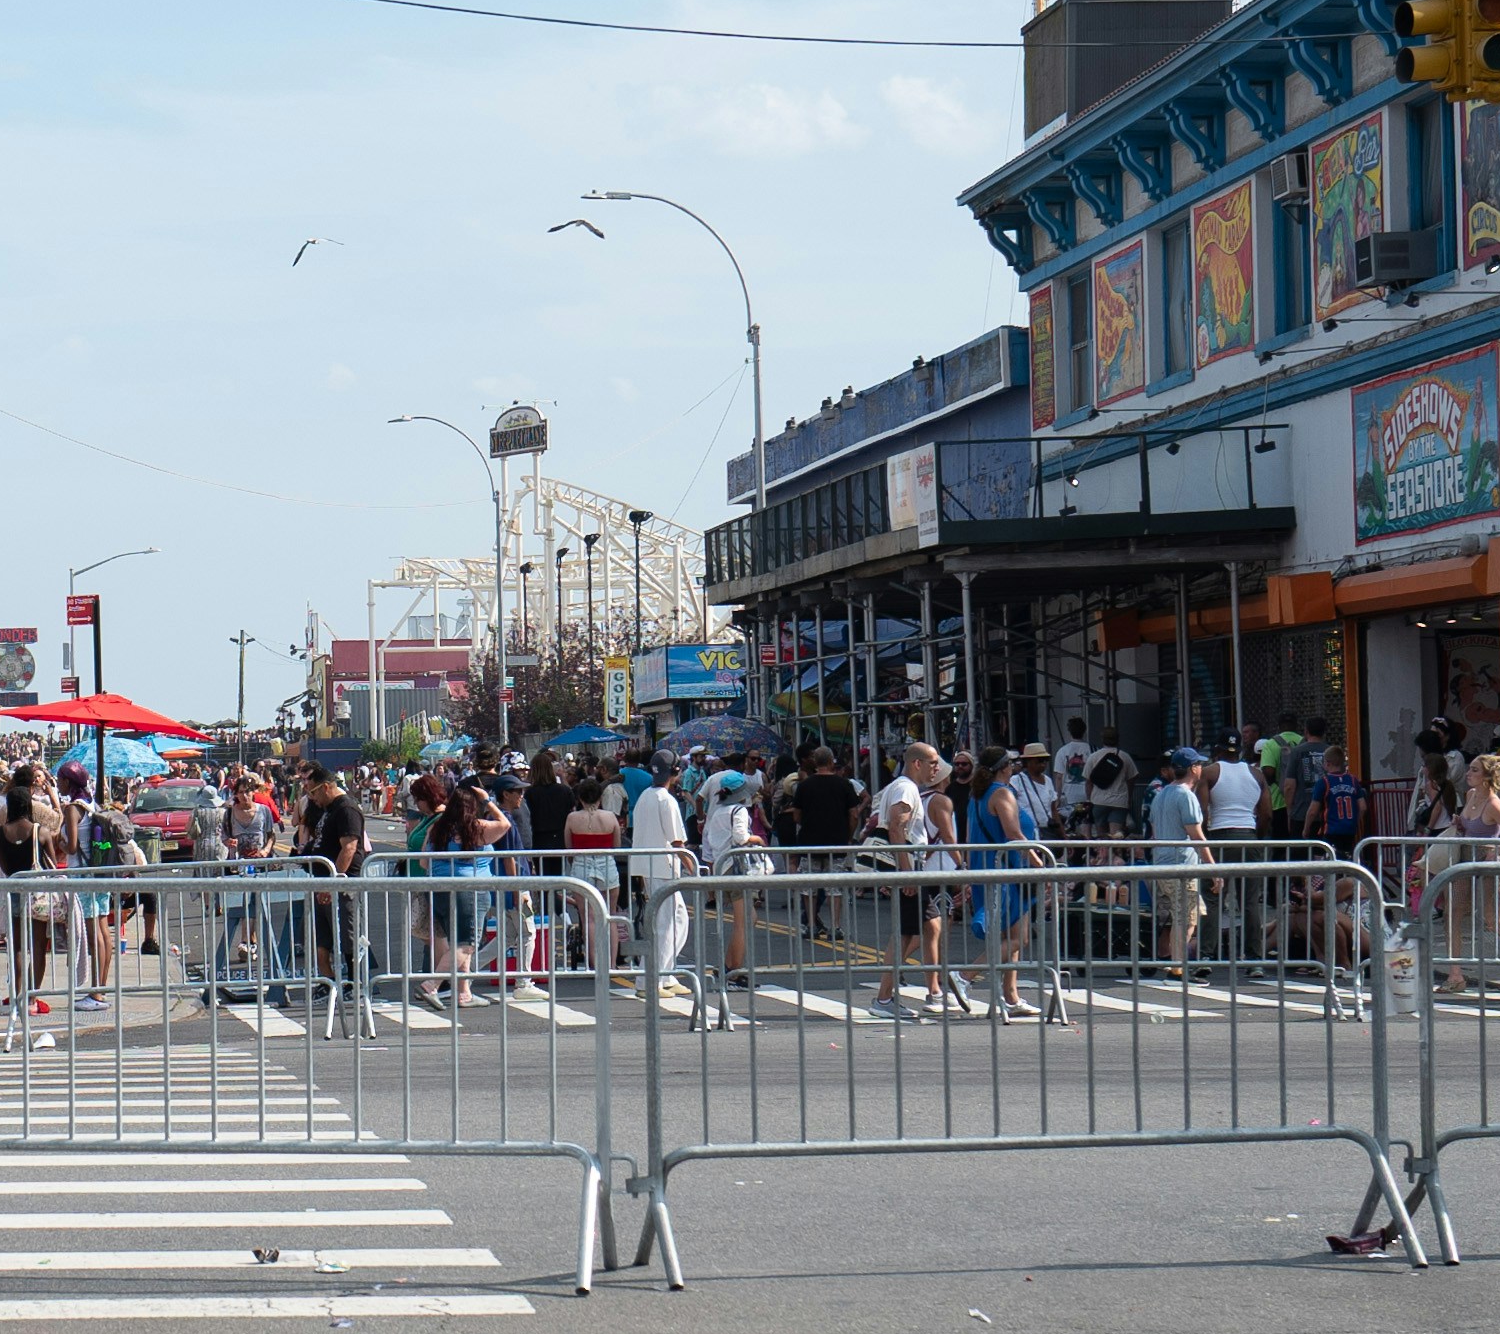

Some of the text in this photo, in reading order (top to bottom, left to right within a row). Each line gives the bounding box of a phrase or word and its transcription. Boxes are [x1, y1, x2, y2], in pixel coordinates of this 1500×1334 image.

[1383, 383, 1462, 471] SIDESHOWS
[1408, 432, 1437, 462] BY THE
[1387, 455, 1466, 521] SEASHORE
[613, 672, 625, 718] GOLF
[618, 738, 640, 750] ATM
[1336, 796, 1353, 820] 11
[249, 970, 268, 979] DET
